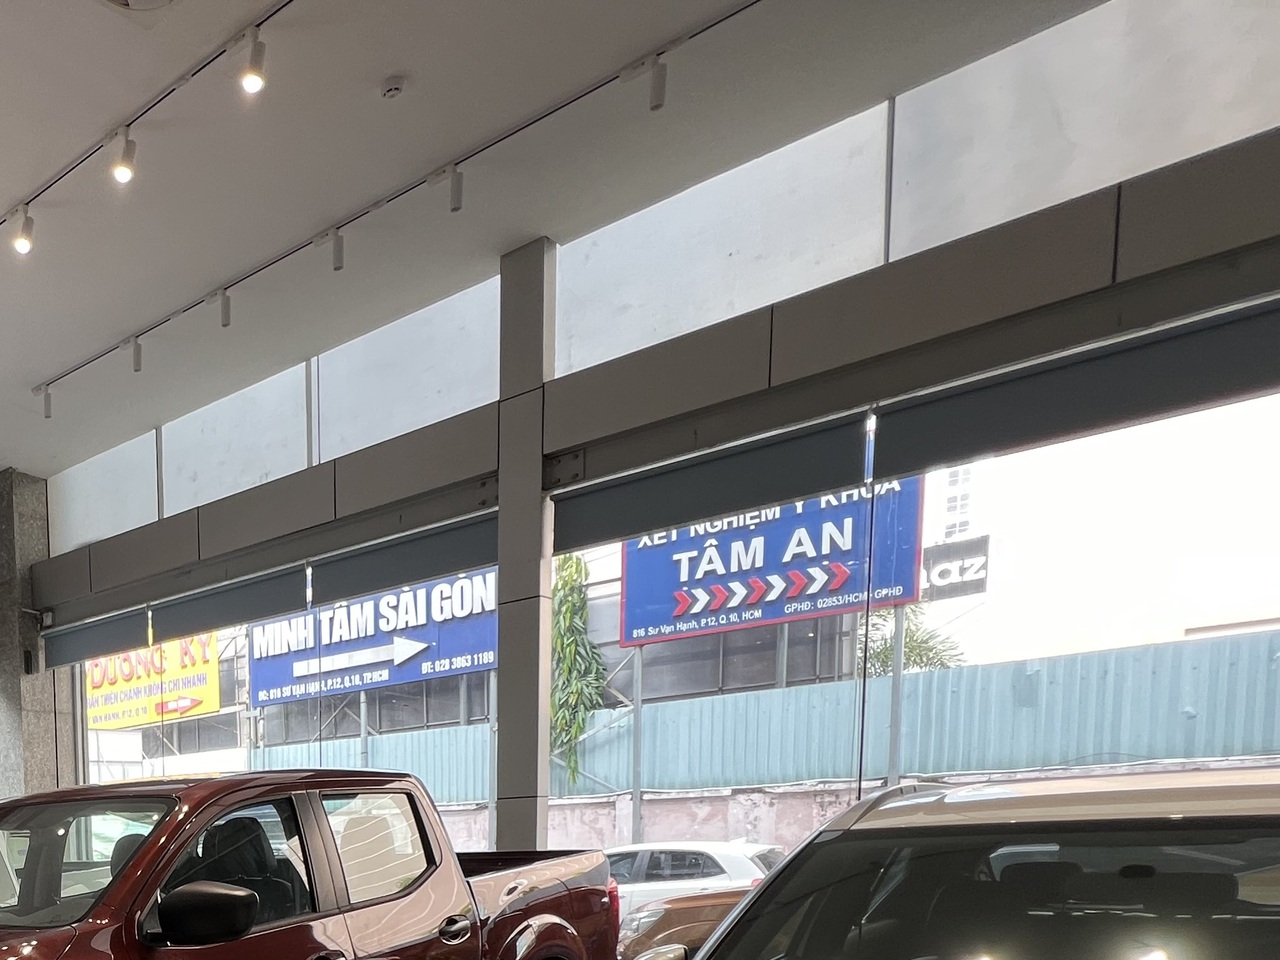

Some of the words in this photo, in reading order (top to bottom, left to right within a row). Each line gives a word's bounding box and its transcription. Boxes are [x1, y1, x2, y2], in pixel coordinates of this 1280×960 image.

[672, 536, 765, 582] TÂM
[782, 517, 853, 563] AN
[252, 613, 315, 659] MINH
[320, 601, 375, 645] TÂM
[379, 586, 427, 632] SÀI
[431, 571, 497, 623] GÒN
[632, 629, 645, 638] 816
[742, 609, 762, 621] HCM
[435, 659, 450, 672] 028
[473, 651, 494, 666] 1189
